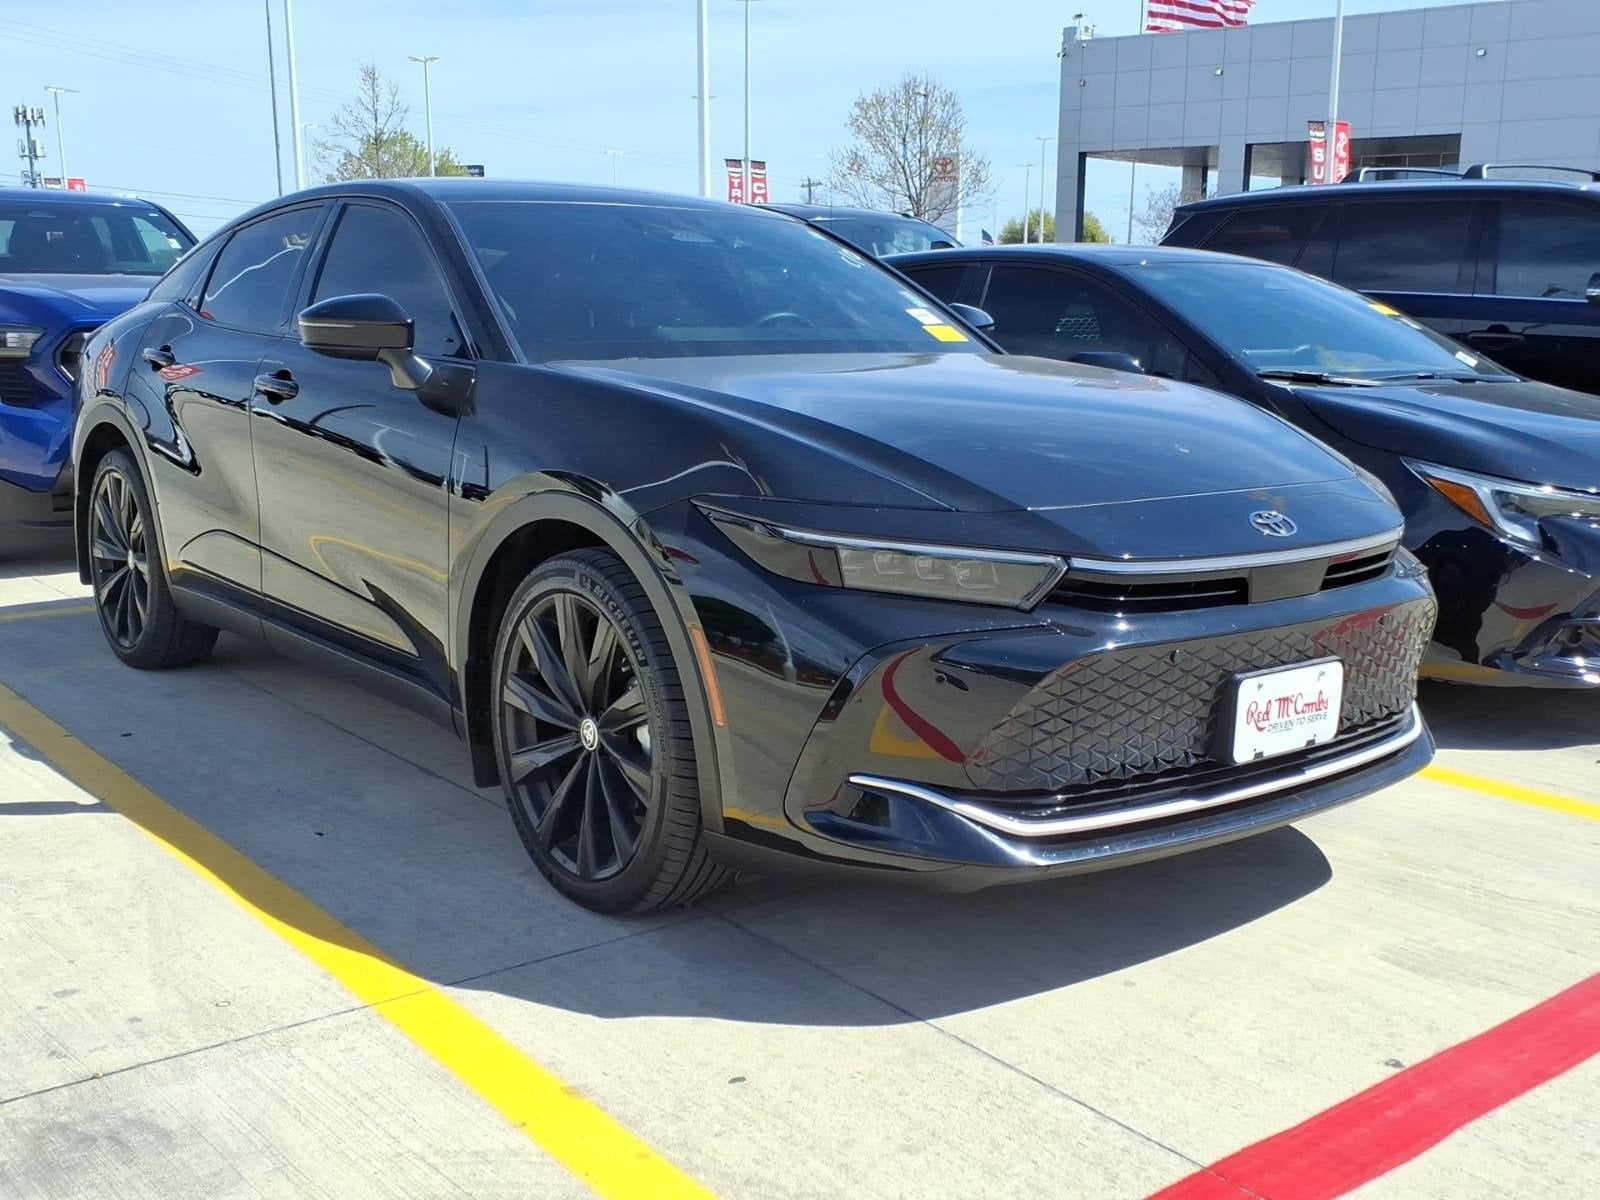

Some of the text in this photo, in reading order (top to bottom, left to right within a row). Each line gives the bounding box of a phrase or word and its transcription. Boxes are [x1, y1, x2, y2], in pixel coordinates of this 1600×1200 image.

[593, 584, 646, 662] MICHELIN
[1246, 690, 1329, 732] Red McCombs
[1267, 712, 1328, 732] DRIVEN TO SERVE
